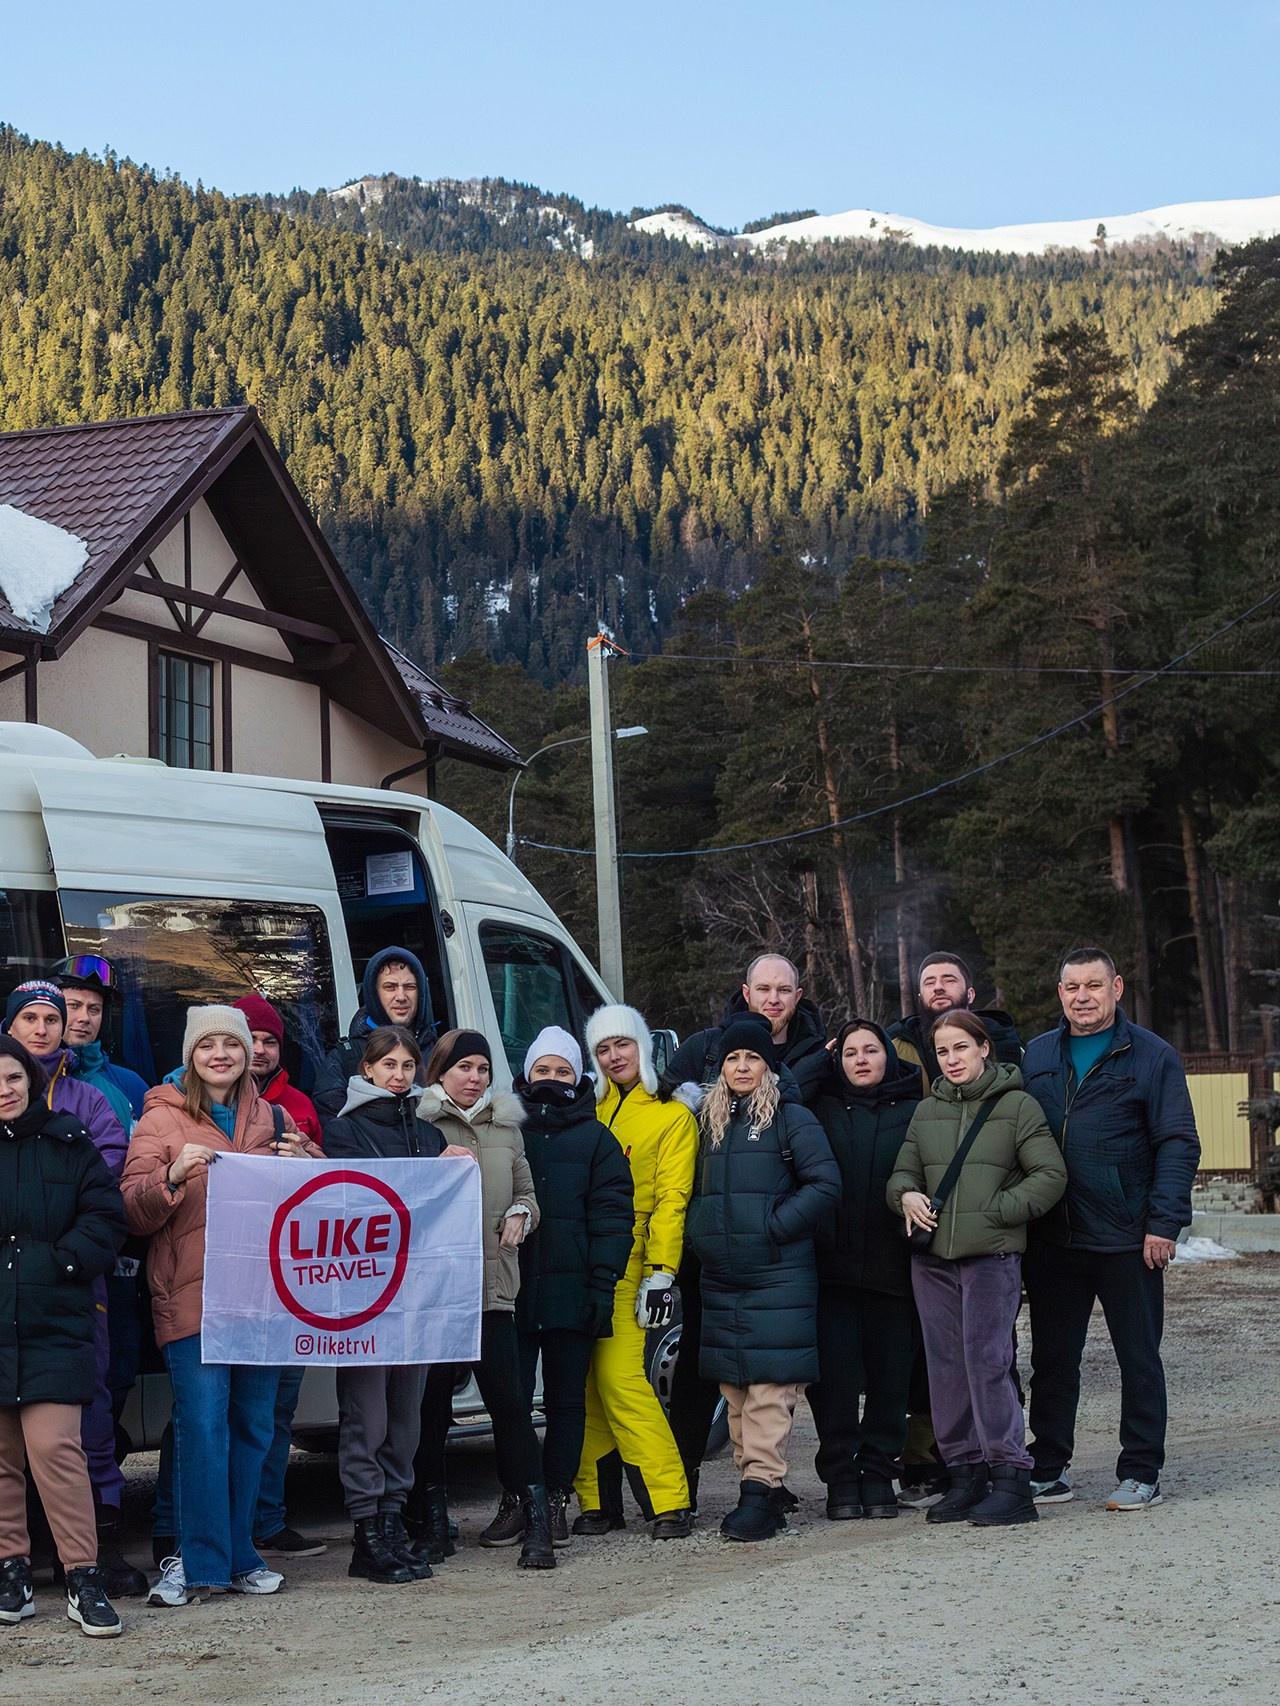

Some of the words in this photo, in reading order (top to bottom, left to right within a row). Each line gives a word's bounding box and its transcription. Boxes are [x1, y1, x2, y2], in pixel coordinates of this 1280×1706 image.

[289, 1214, 392, 1260] LIKE
[292, 1258, 386, 1286] TRAVEL
[317, 1335, 376, 1355] liketrvl
